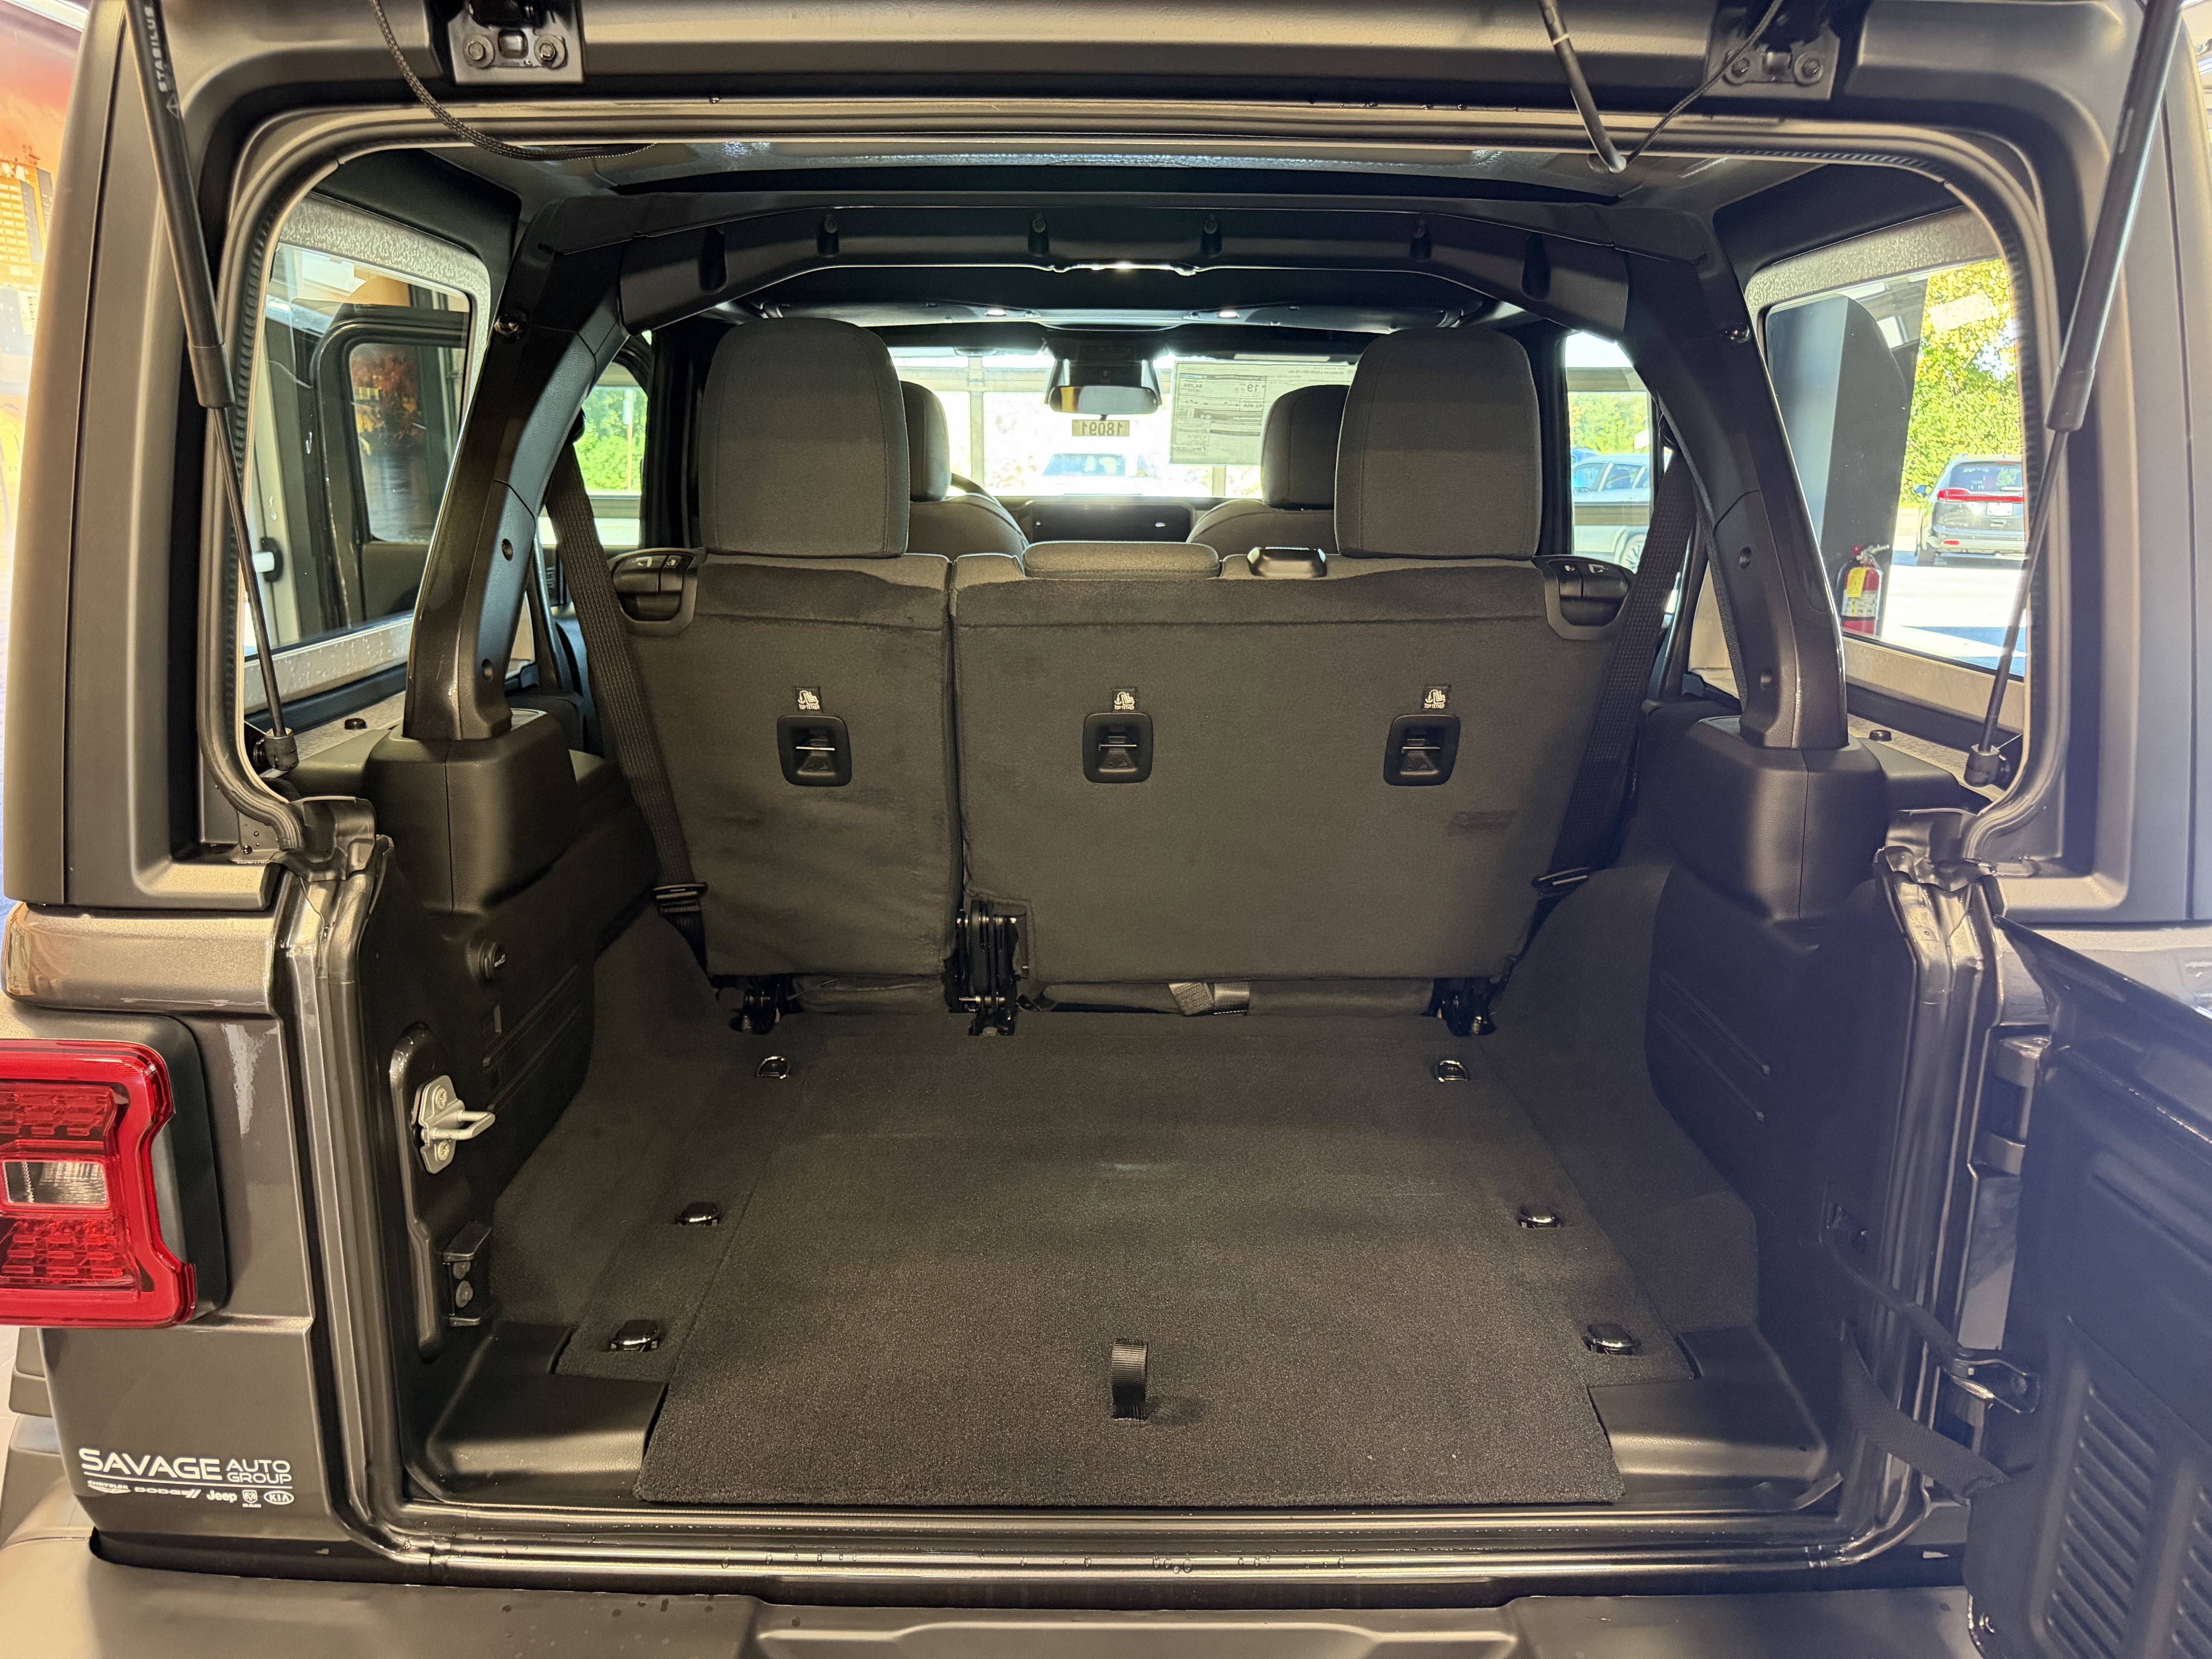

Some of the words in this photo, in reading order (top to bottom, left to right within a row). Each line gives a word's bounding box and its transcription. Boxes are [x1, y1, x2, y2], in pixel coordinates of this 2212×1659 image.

[144, 6, 168, 92] STABILUS
[79, 1448, 223, 1480] SAVAGE
[226, 1458, 290, 1473] AUTO
[88, 1480, 129, 1490] CHRYSLER
[134, 1487, 194, 1496] DODGE
[206, 1490, 237, 1503] Jeep
[269, 1494, 290, 1502] KIA
[227, 1473, 292, 1484] GROUP
